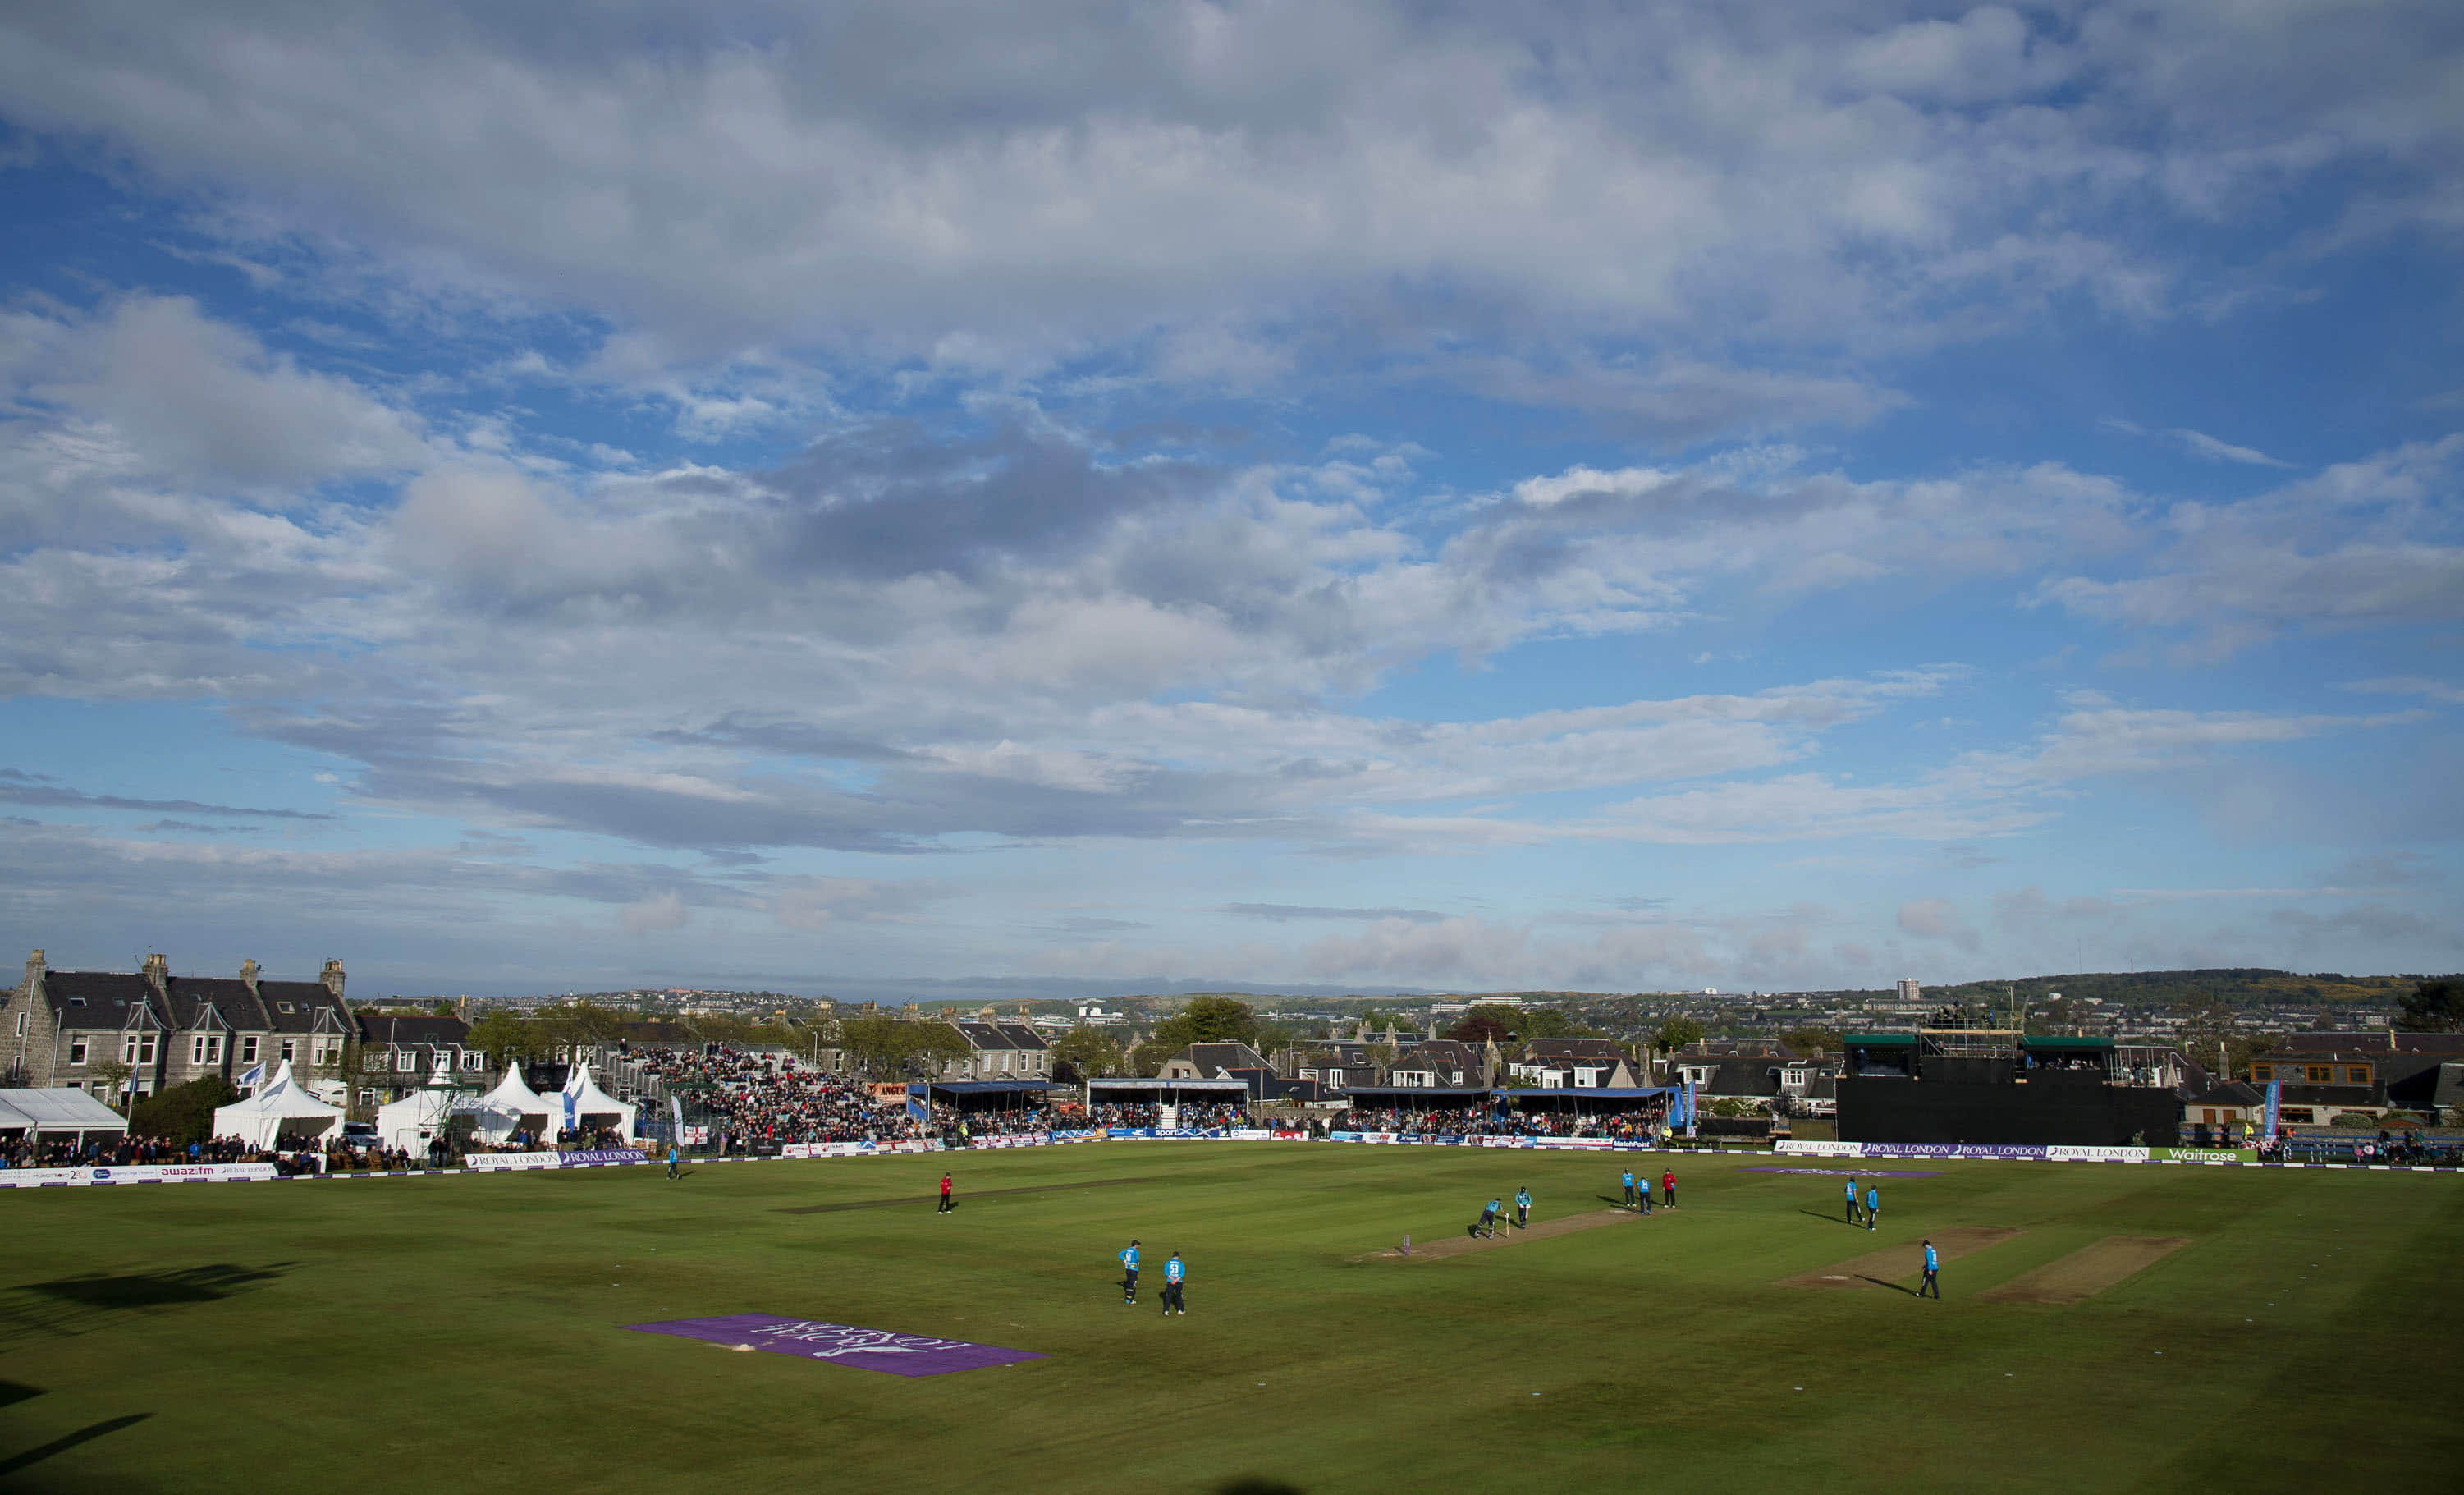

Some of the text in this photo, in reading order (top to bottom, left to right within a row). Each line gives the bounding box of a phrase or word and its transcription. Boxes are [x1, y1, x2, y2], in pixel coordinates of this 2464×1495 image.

[1786, 1140, 1858, 1152] ROYAL LONDON
[1871, 1144, 1949, 1155] ROYAL LONDON
[1962, 1145, 2044, 1156] ROYAL LONDON
[570, 1150, 645, 1163] ROYAL LONDON
[2059, 1147, 2147, 1158] ROYAL LONDON
[2169, 1148, 2237, 1162] Waitrose
[479, 1153, 558, 1166] ROYAL LONDON
